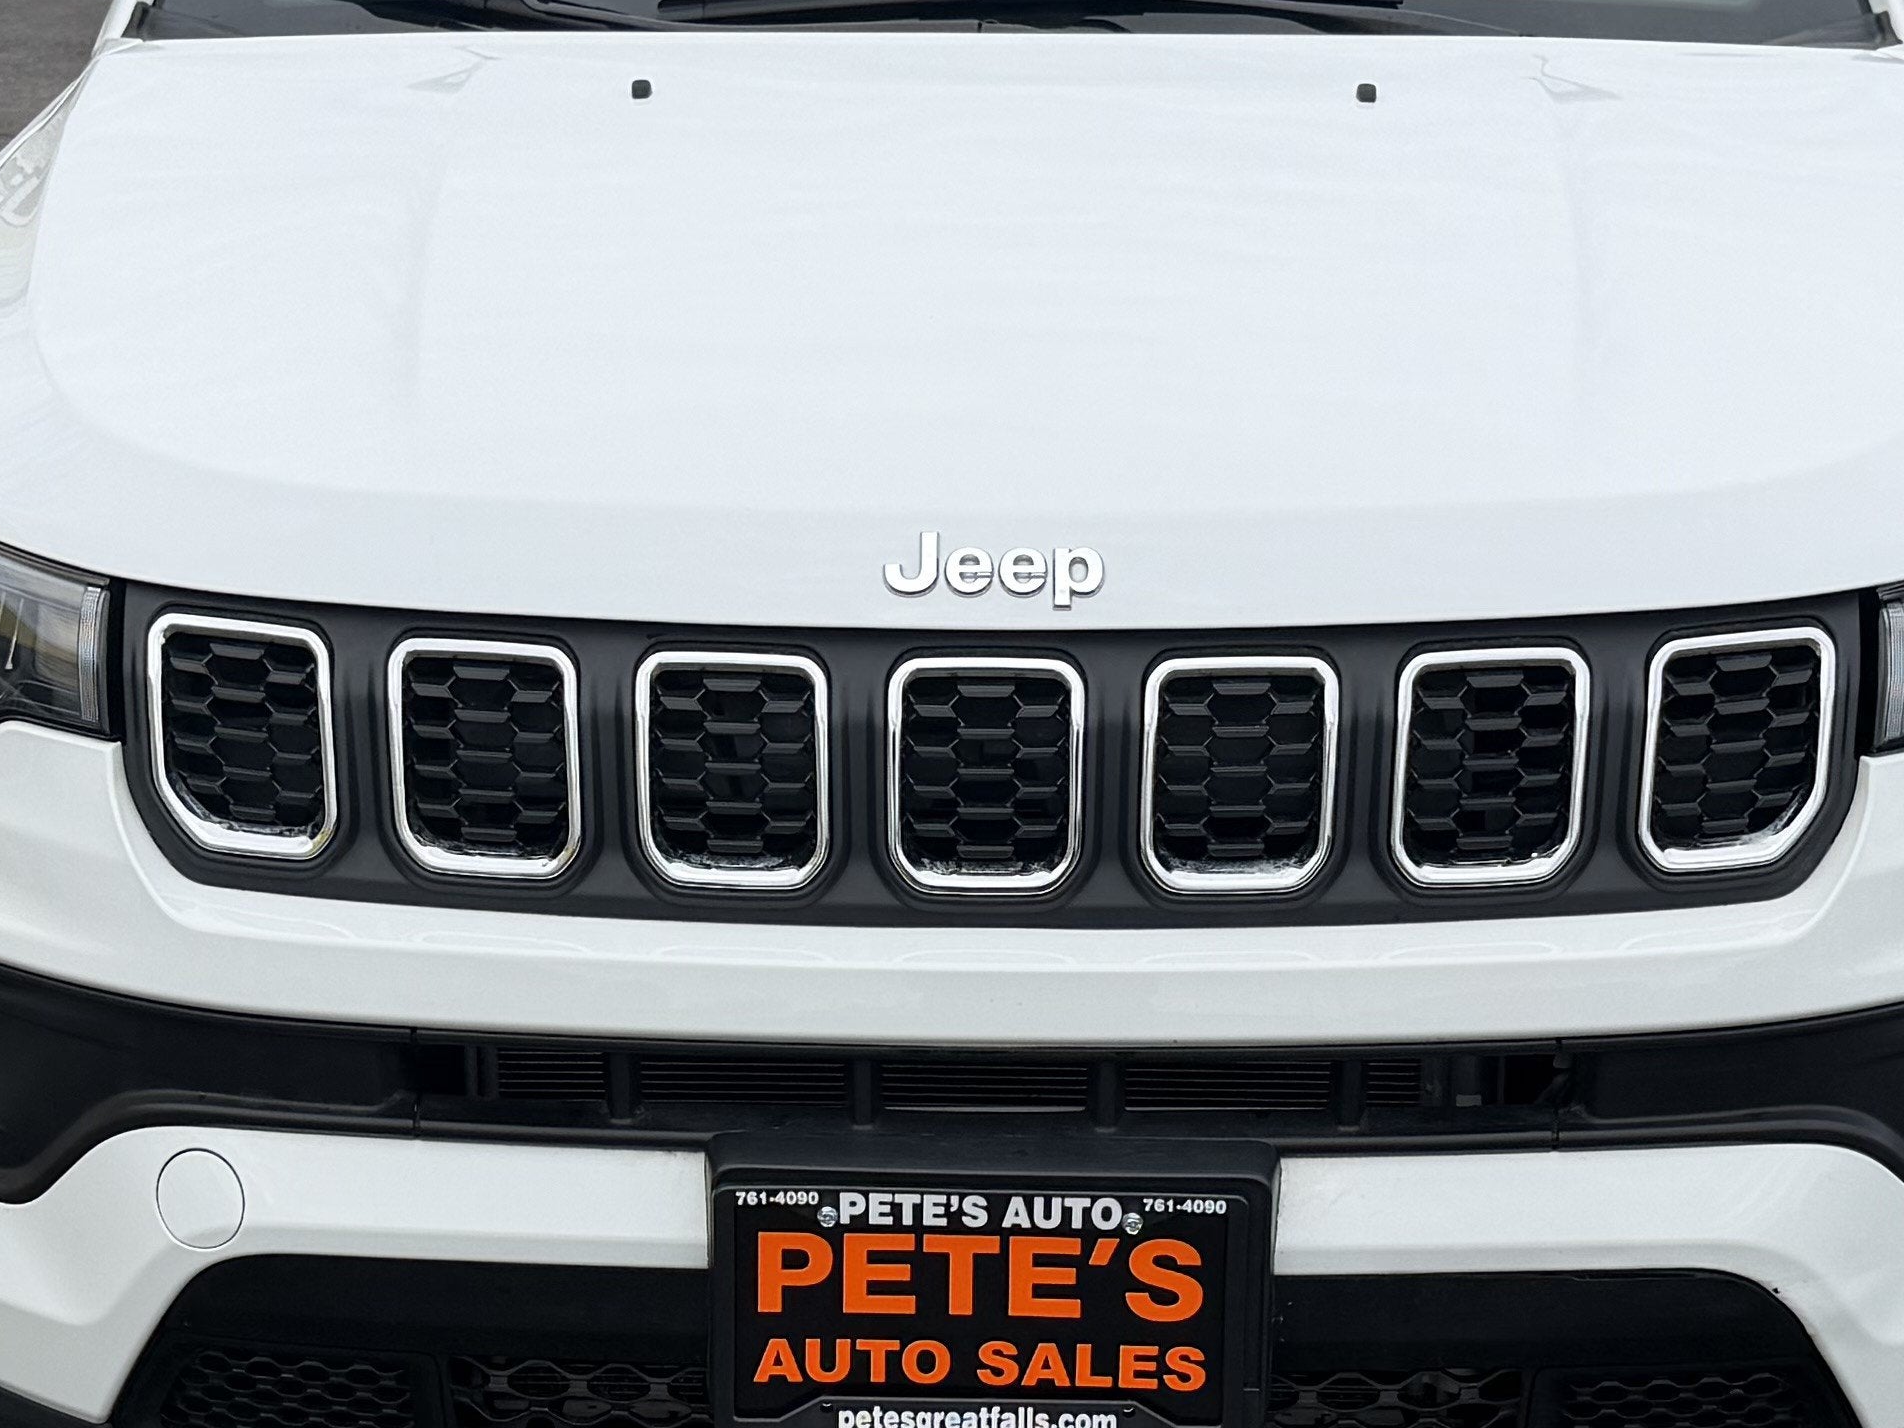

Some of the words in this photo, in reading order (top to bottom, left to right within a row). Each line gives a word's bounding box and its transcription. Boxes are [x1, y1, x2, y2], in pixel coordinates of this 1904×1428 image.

[883, 531, 1104, 611] Jeep
[735, 1190, 819, 1206] 761-4090
[839, 1192, 989, 1228] PETE'S
[1002, 1195, 1123, 1231] AUTO
[1143, 1198, 1227, 1214] 761-4090
[757, 1231, 1204, 1322] PETE'S
[754, 1338, 951, 1384] AUTO
[977, 1341, 1206, 1392] SALES
